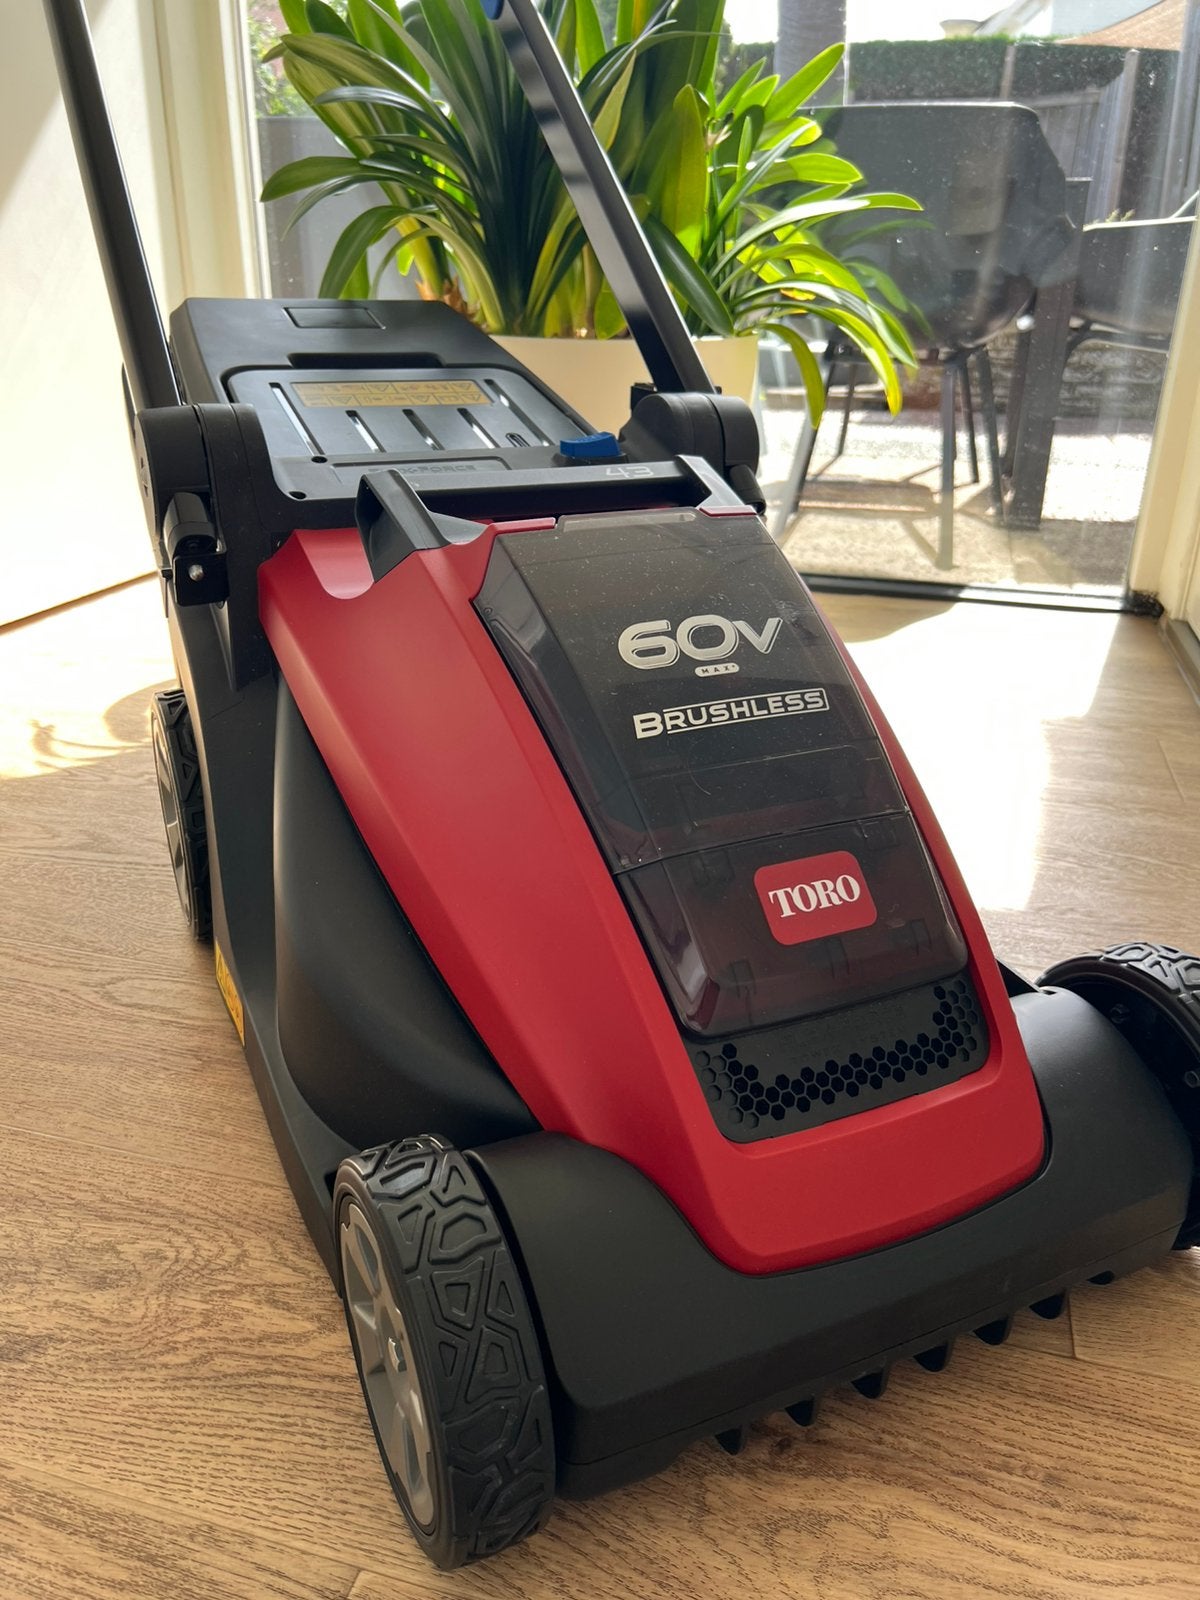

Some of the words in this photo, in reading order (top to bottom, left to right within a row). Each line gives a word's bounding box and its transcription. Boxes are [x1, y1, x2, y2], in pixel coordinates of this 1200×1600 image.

[606, 466, 654, 478] 43
[633, 691, 824, 739] BRUSHLESS
[768, 874, 861, 918] TORO
